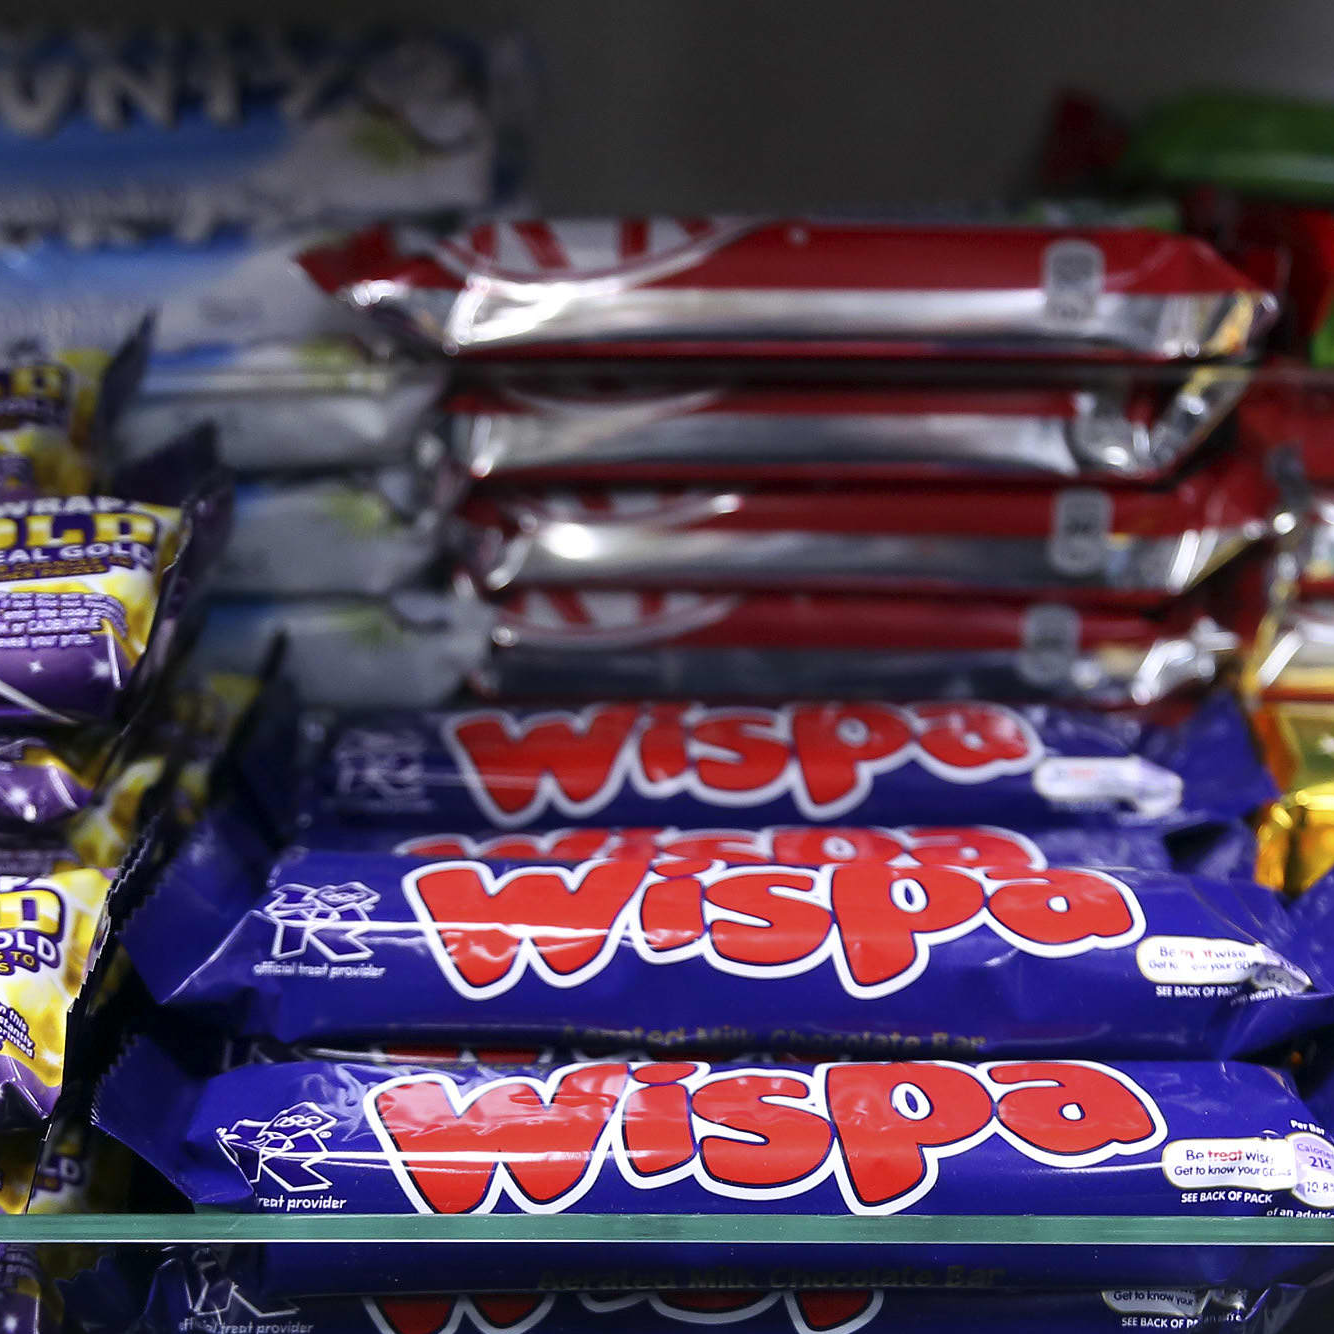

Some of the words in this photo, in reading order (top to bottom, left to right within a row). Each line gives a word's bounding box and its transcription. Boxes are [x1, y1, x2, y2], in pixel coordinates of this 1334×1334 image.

[59, 543, 156, 566] GOLD
[442, 703, 1045, 827] Wispa
[403, 858, 1146, 1000] Wispa
[10, 950, 36, 969] TO
[329, 964, 386, 979] provider
[9, 1009, 28, 1033] this
[770, 1028, 921, 1052] Chocolate
[930, 1031, 987, 1051] Bar
[364, 1060, 1167, 1215] Wispa
[1174, 1166, 1193, 1176] Get
[1195, 1166, 1206, 1176] to
[1208, 1164, 1236, 1176] know
[1237, 1166, 1261, 1179] your
[1308, 1156, 1333, 1171] 215
[257, 1195, 285, 1210] reat
[287, 1194, 347, 1213] provider
[1180, 1193, 1199, 1204] SEE
[1199, 1191, 1226, 1203] BACK
[1227, 1190, 1244, 1202] OF
[1244, 1192, 1273, 1204] PACK
